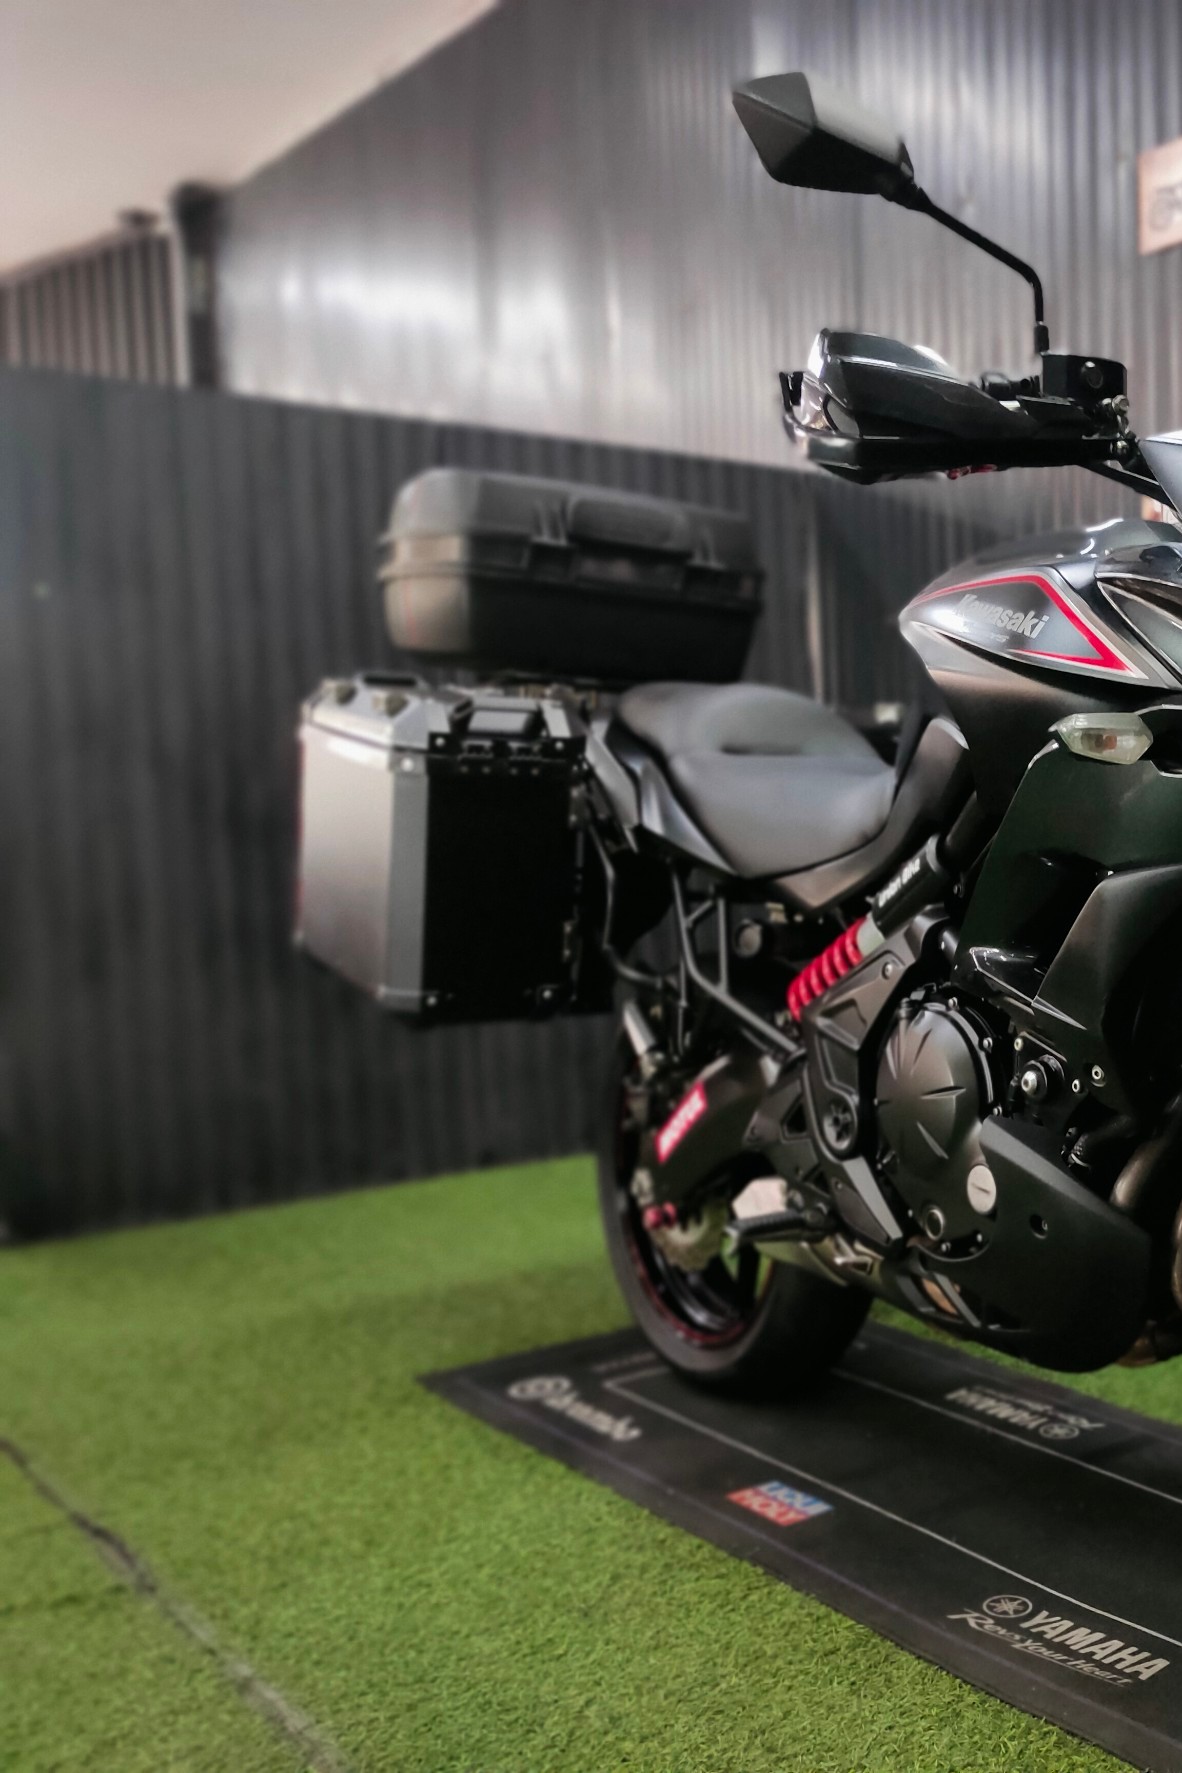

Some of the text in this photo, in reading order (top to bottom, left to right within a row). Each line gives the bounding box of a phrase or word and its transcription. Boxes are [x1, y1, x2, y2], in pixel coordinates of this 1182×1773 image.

[960, 593, 1050, 640] Kawasaki
[946, 1608, 1134, 1685] Revs Your Heart
[1018, 1610, 1171, 1681] YAMAHA
